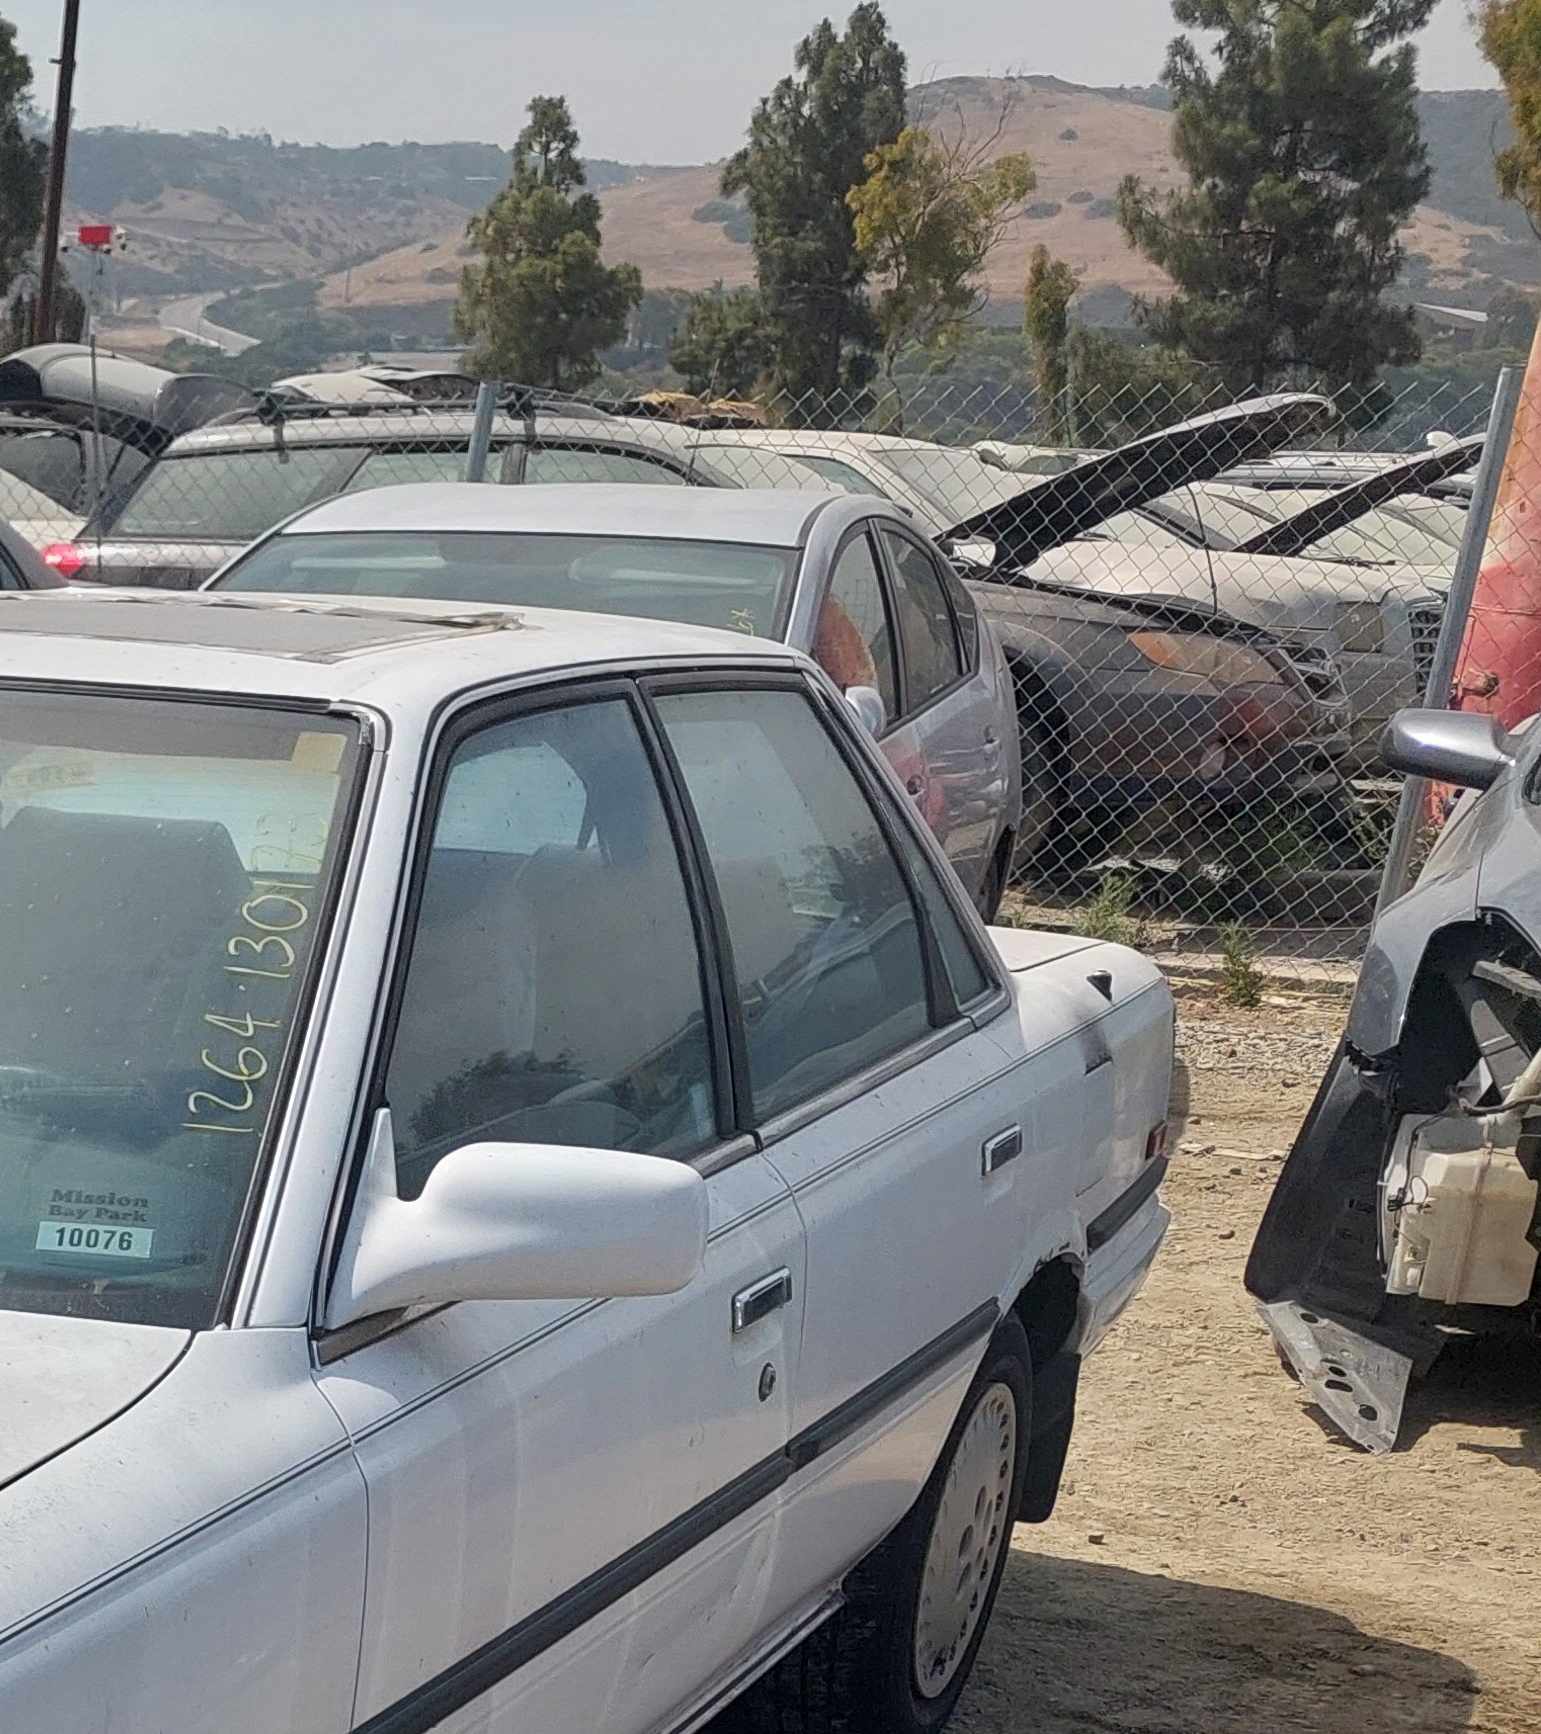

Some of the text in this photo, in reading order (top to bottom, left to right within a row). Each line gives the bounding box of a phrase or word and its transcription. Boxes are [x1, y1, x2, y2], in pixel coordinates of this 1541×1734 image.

[51, 1189, 149, 1207] Mission
[48, 1204, 148, 1223] Bay Park
[55, 1226, 134, 1251] 10076
